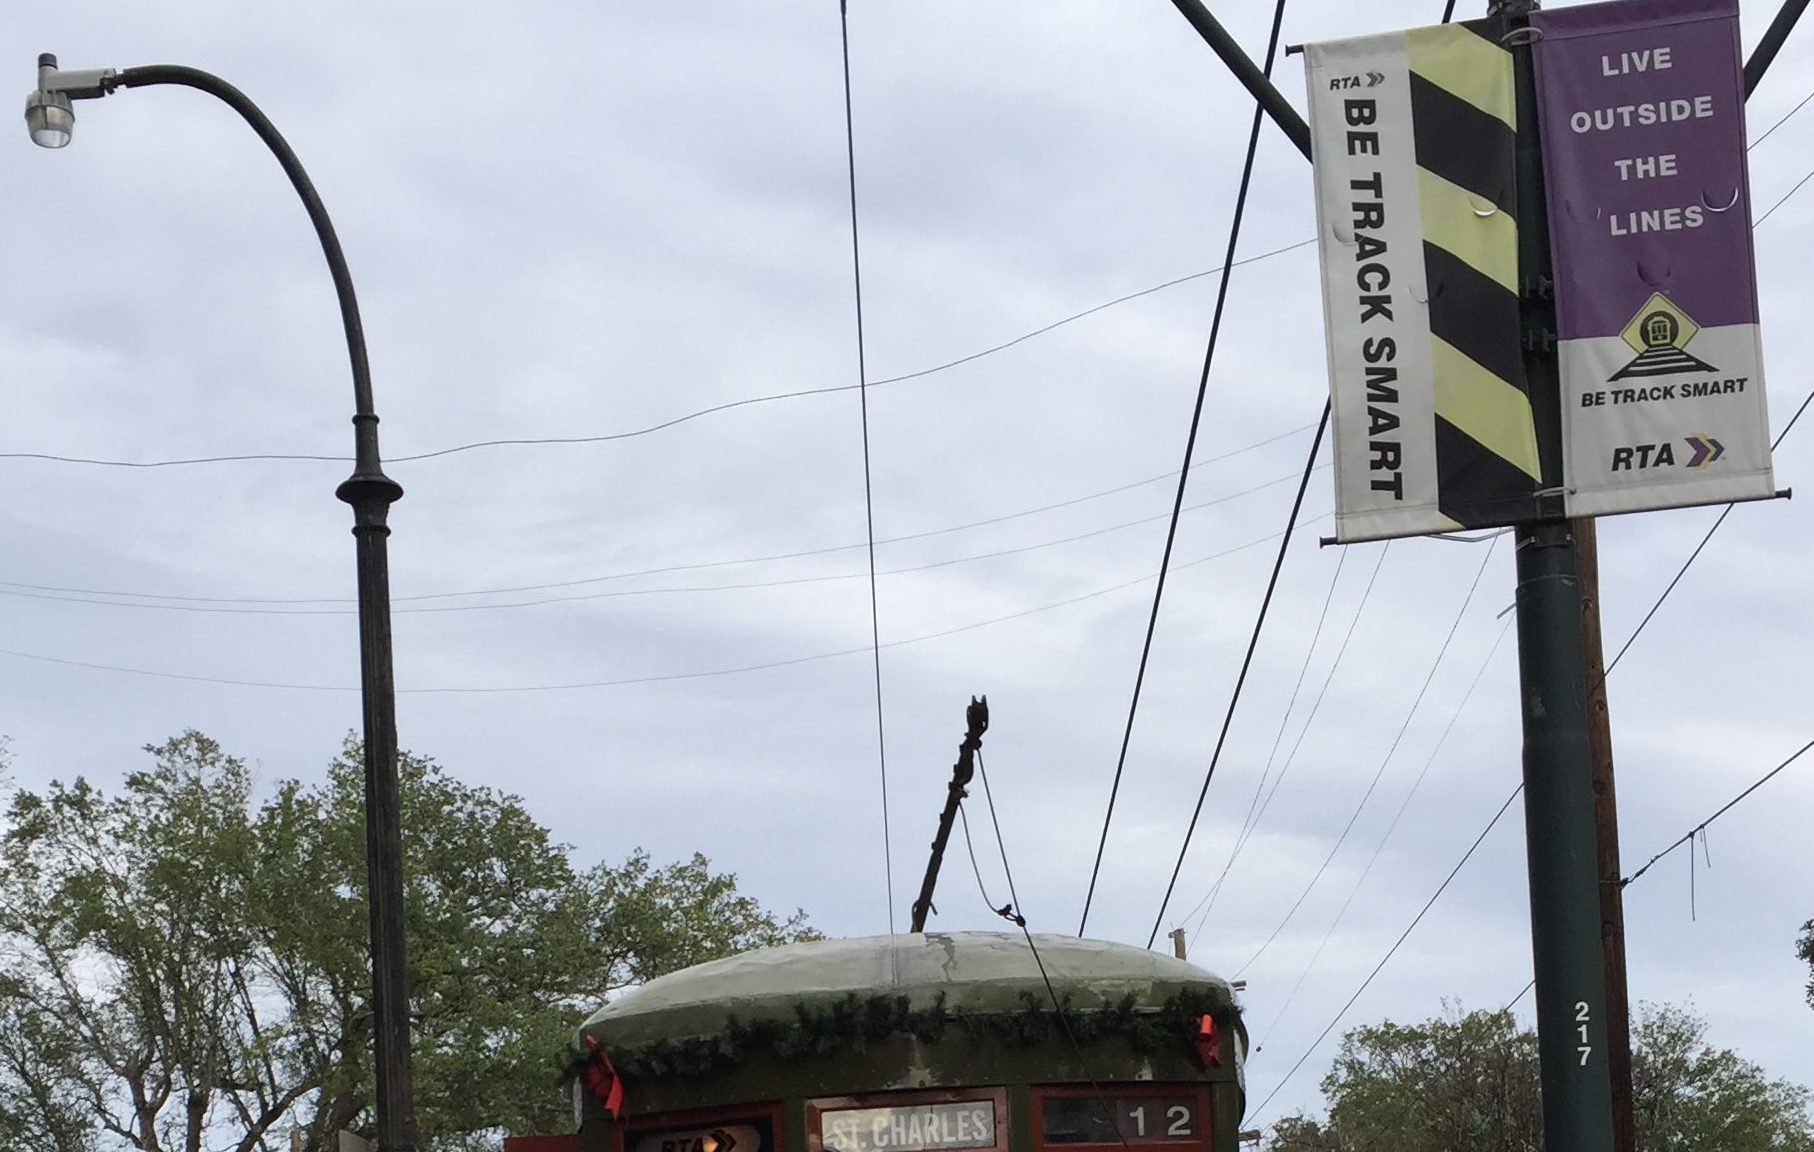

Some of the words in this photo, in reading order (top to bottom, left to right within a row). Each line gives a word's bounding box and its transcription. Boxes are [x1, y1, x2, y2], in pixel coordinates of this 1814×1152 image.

[1601, 47, 1672, 77] LIVE
[1329, 75, 1362, 91] RTA
[1343, 98, 1380, 157] BE
[1570, 96, 1714, 134] OUTSIDE
[1614, 154, 1678, 181] THE
[1610, 206, 1705, 237] LINES
[1349, 171, 1394, 324] TRACK
[1580, 391, 1607, 409] BE
[1610, 384, 1676, 406] TRACK
[1680, 378, 1748, 400] SMART
[1362, 336, 1403, 500] SMART
[1610, 442, 1675, 472] RTA
[1575, 1001, 1591, 1066] 217
[832, 1118, 867, 1150] ST.
[872, 1110, 988, 1148] CHARLES
